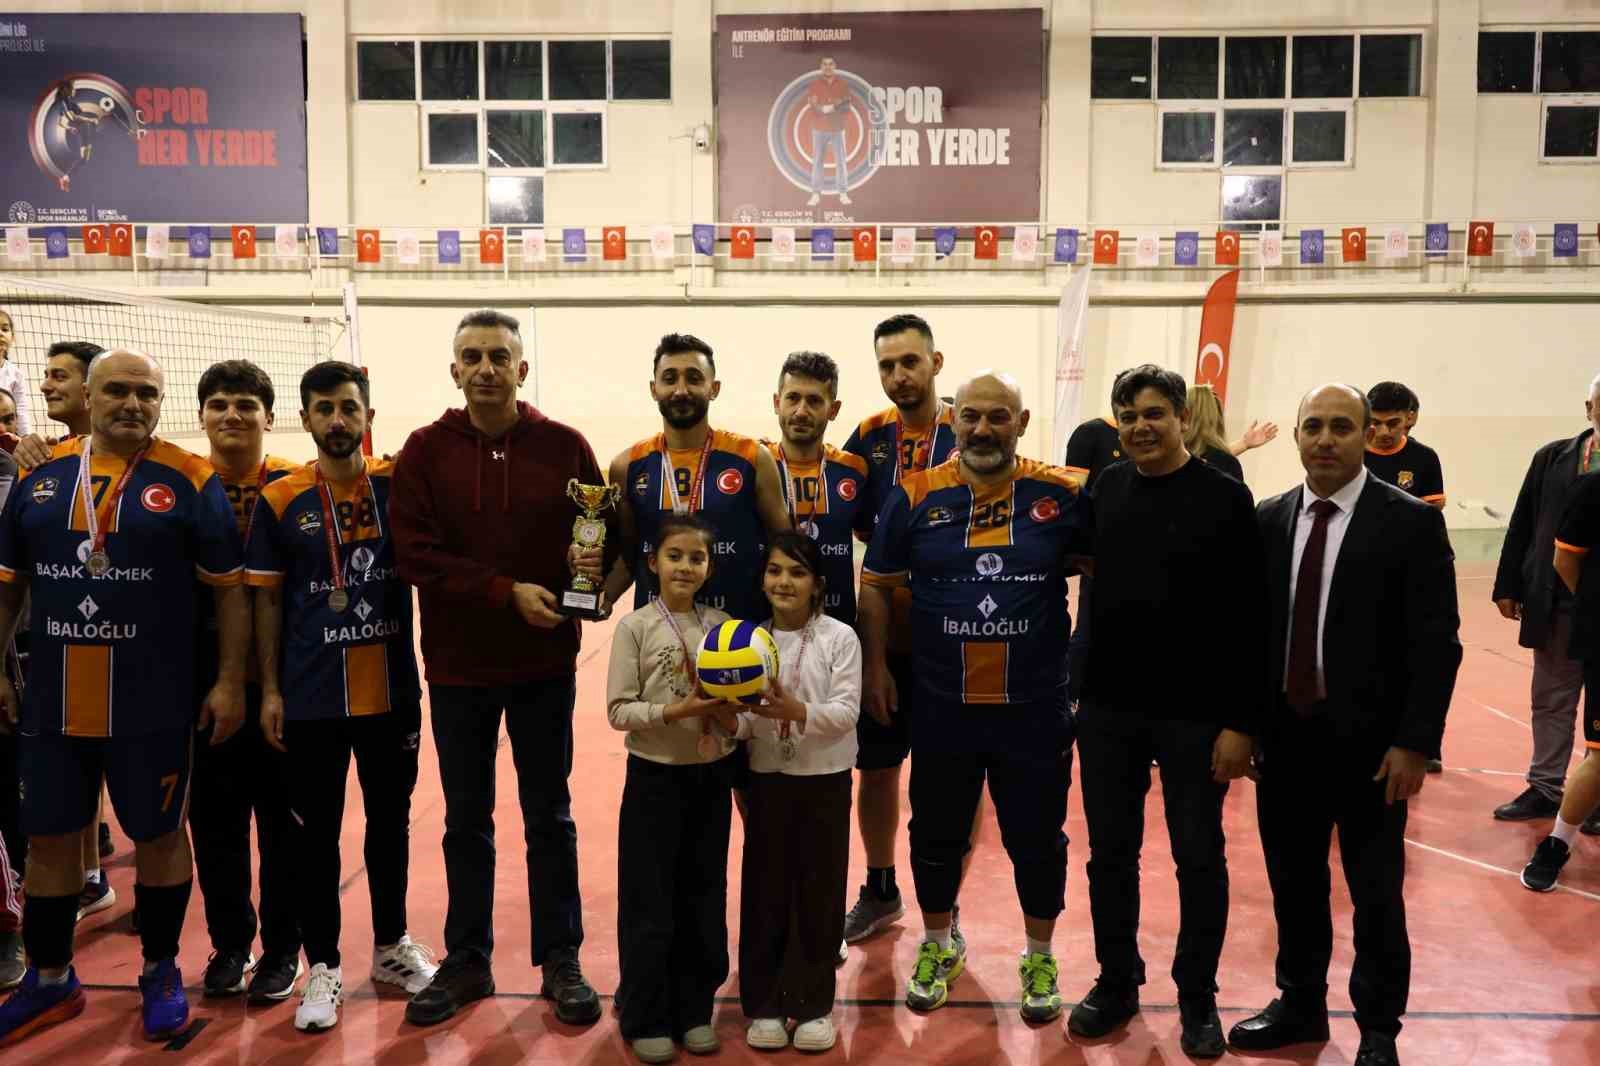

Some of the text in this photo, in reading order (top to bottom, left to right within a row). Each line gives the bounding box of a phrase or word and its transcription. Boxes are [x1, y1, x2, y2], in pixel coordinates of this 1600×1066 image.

[732, 28, 851, 42] ANTRENÖR EĞİTİM PROGRAMI
[135, 87, 208, 124] SPOR
[868, 86, 943, 124] SPOR
[136, 128, 276, 166] HER YERDE
[868, 128, 1010, 167] HER YERDE
[91, 475, 112, 510] 7
[674, 467, 692, 496] 8
[793, 477, 820, 502] 10
[973, 500, 1010, 528] 26
[36, 563, 84, 579] BAŞAK
[47, 617, 137, 639] İBALOĞLU
[323, 618, 400, 644] İBALOĞLU
[943, 616, 1029, 636] İBALOĞLU
[160, 773, 179, 812] 7
